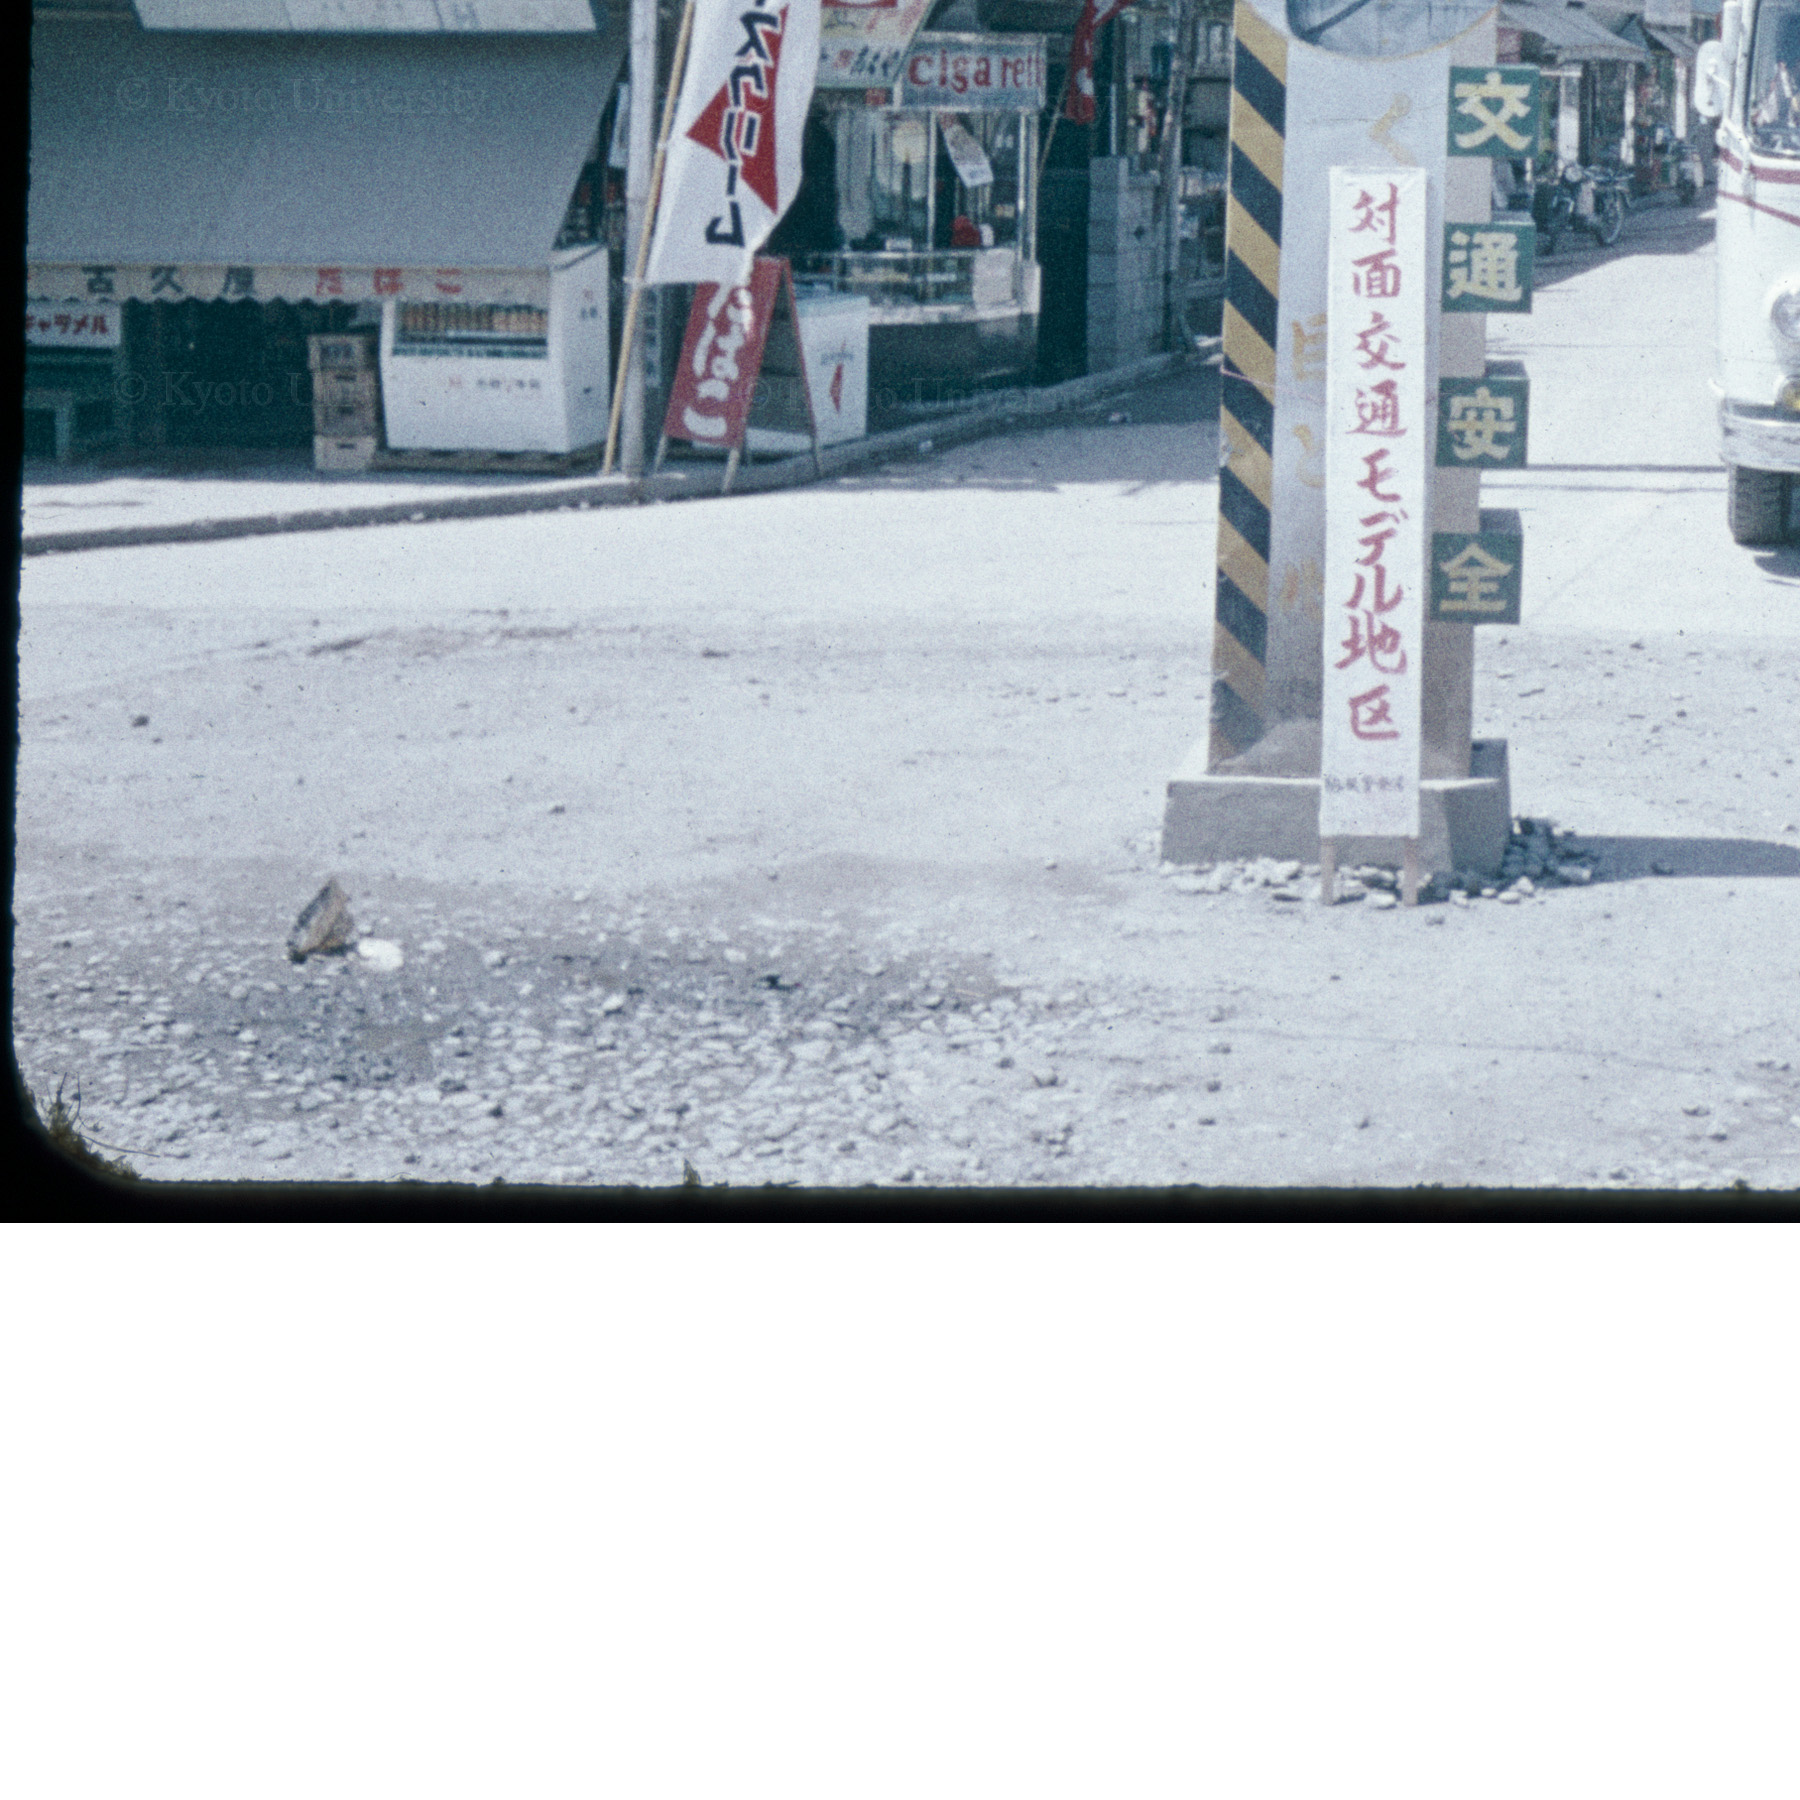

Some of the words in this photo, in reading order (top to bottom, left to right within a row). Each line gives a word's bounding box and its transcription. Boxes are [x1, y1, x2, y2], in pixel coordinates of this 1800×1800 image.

[1335, 183, 1408, 740] 対面交通モデル地区
[1439, 72, 1533, 611] 交通安全
